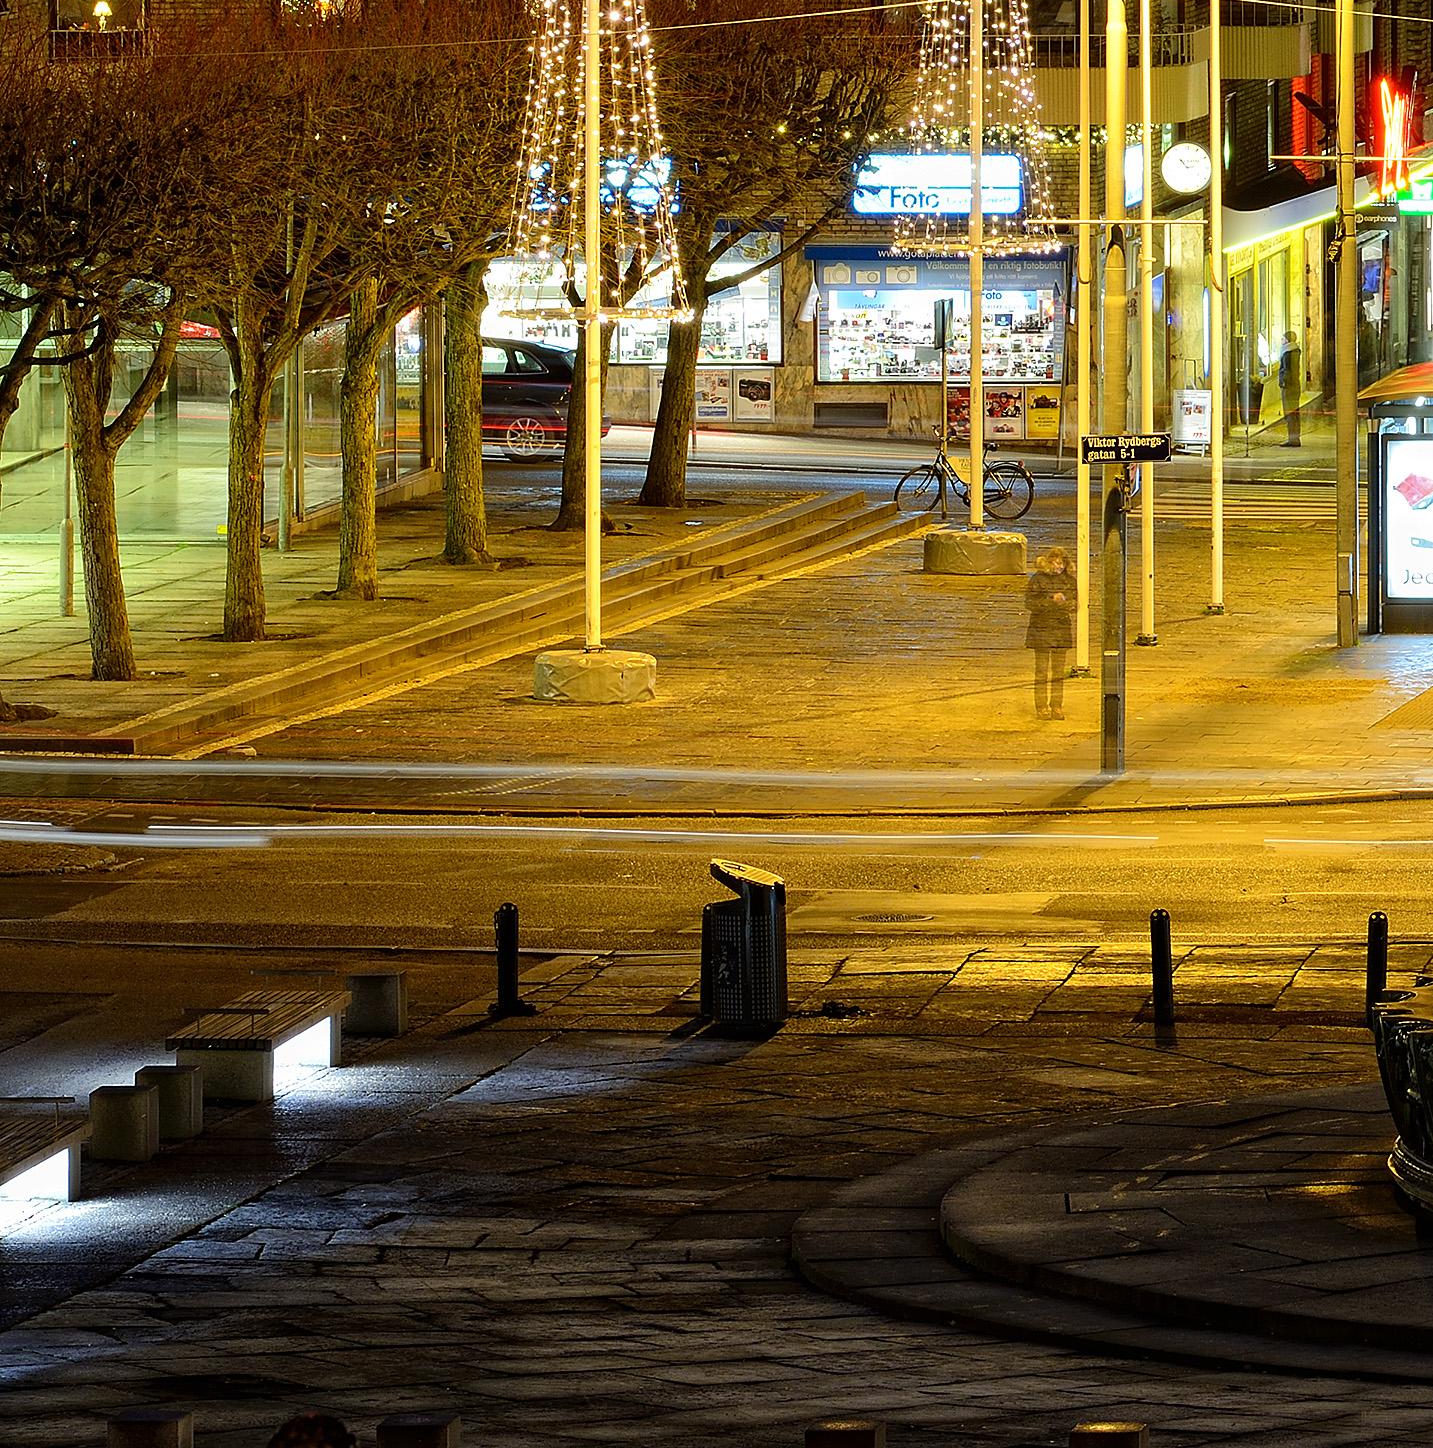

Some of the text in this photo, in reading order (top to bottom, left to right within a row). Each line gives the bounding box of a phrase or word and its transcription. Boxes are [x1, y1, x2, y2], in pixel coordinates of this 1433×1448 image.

[890, 187, 940, 209] Foto
[1363, 215, 1398, 223] earphones
[926, 262, 970, 270] Välkomme
[1000, 260, 1021, 272] riktig
[1023, 260, 1063, 270] fotobutik!
[1087, 436, 1166, 449] Viktor Rydbergs-
[1087, 448, 1136, 462] gatan 5-1
